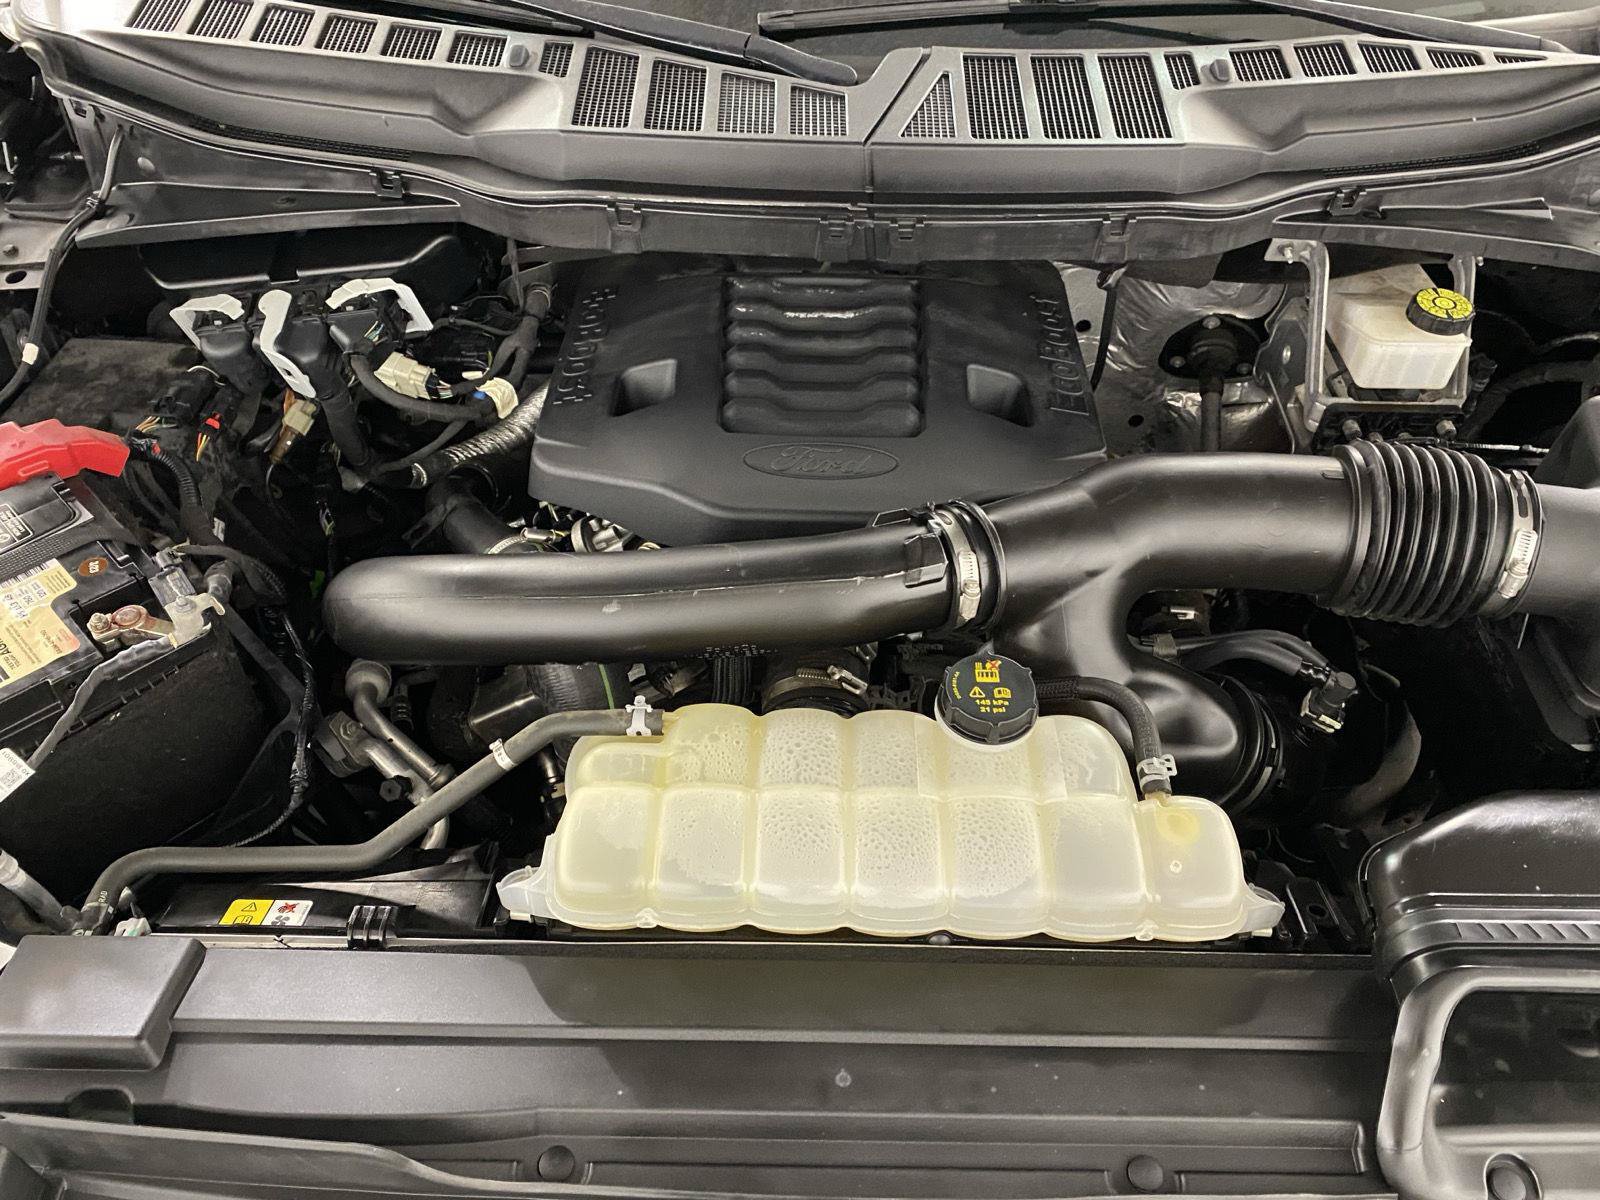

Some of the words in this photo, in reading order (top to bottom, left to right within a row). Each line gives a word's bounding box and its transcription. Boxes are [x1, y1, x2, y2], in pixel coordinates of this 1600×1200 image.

[1028, 291, 1090, 416] EcoBoost
[769, 445, 874, 475] Ford
[992, 706, 1006, 714] psi
